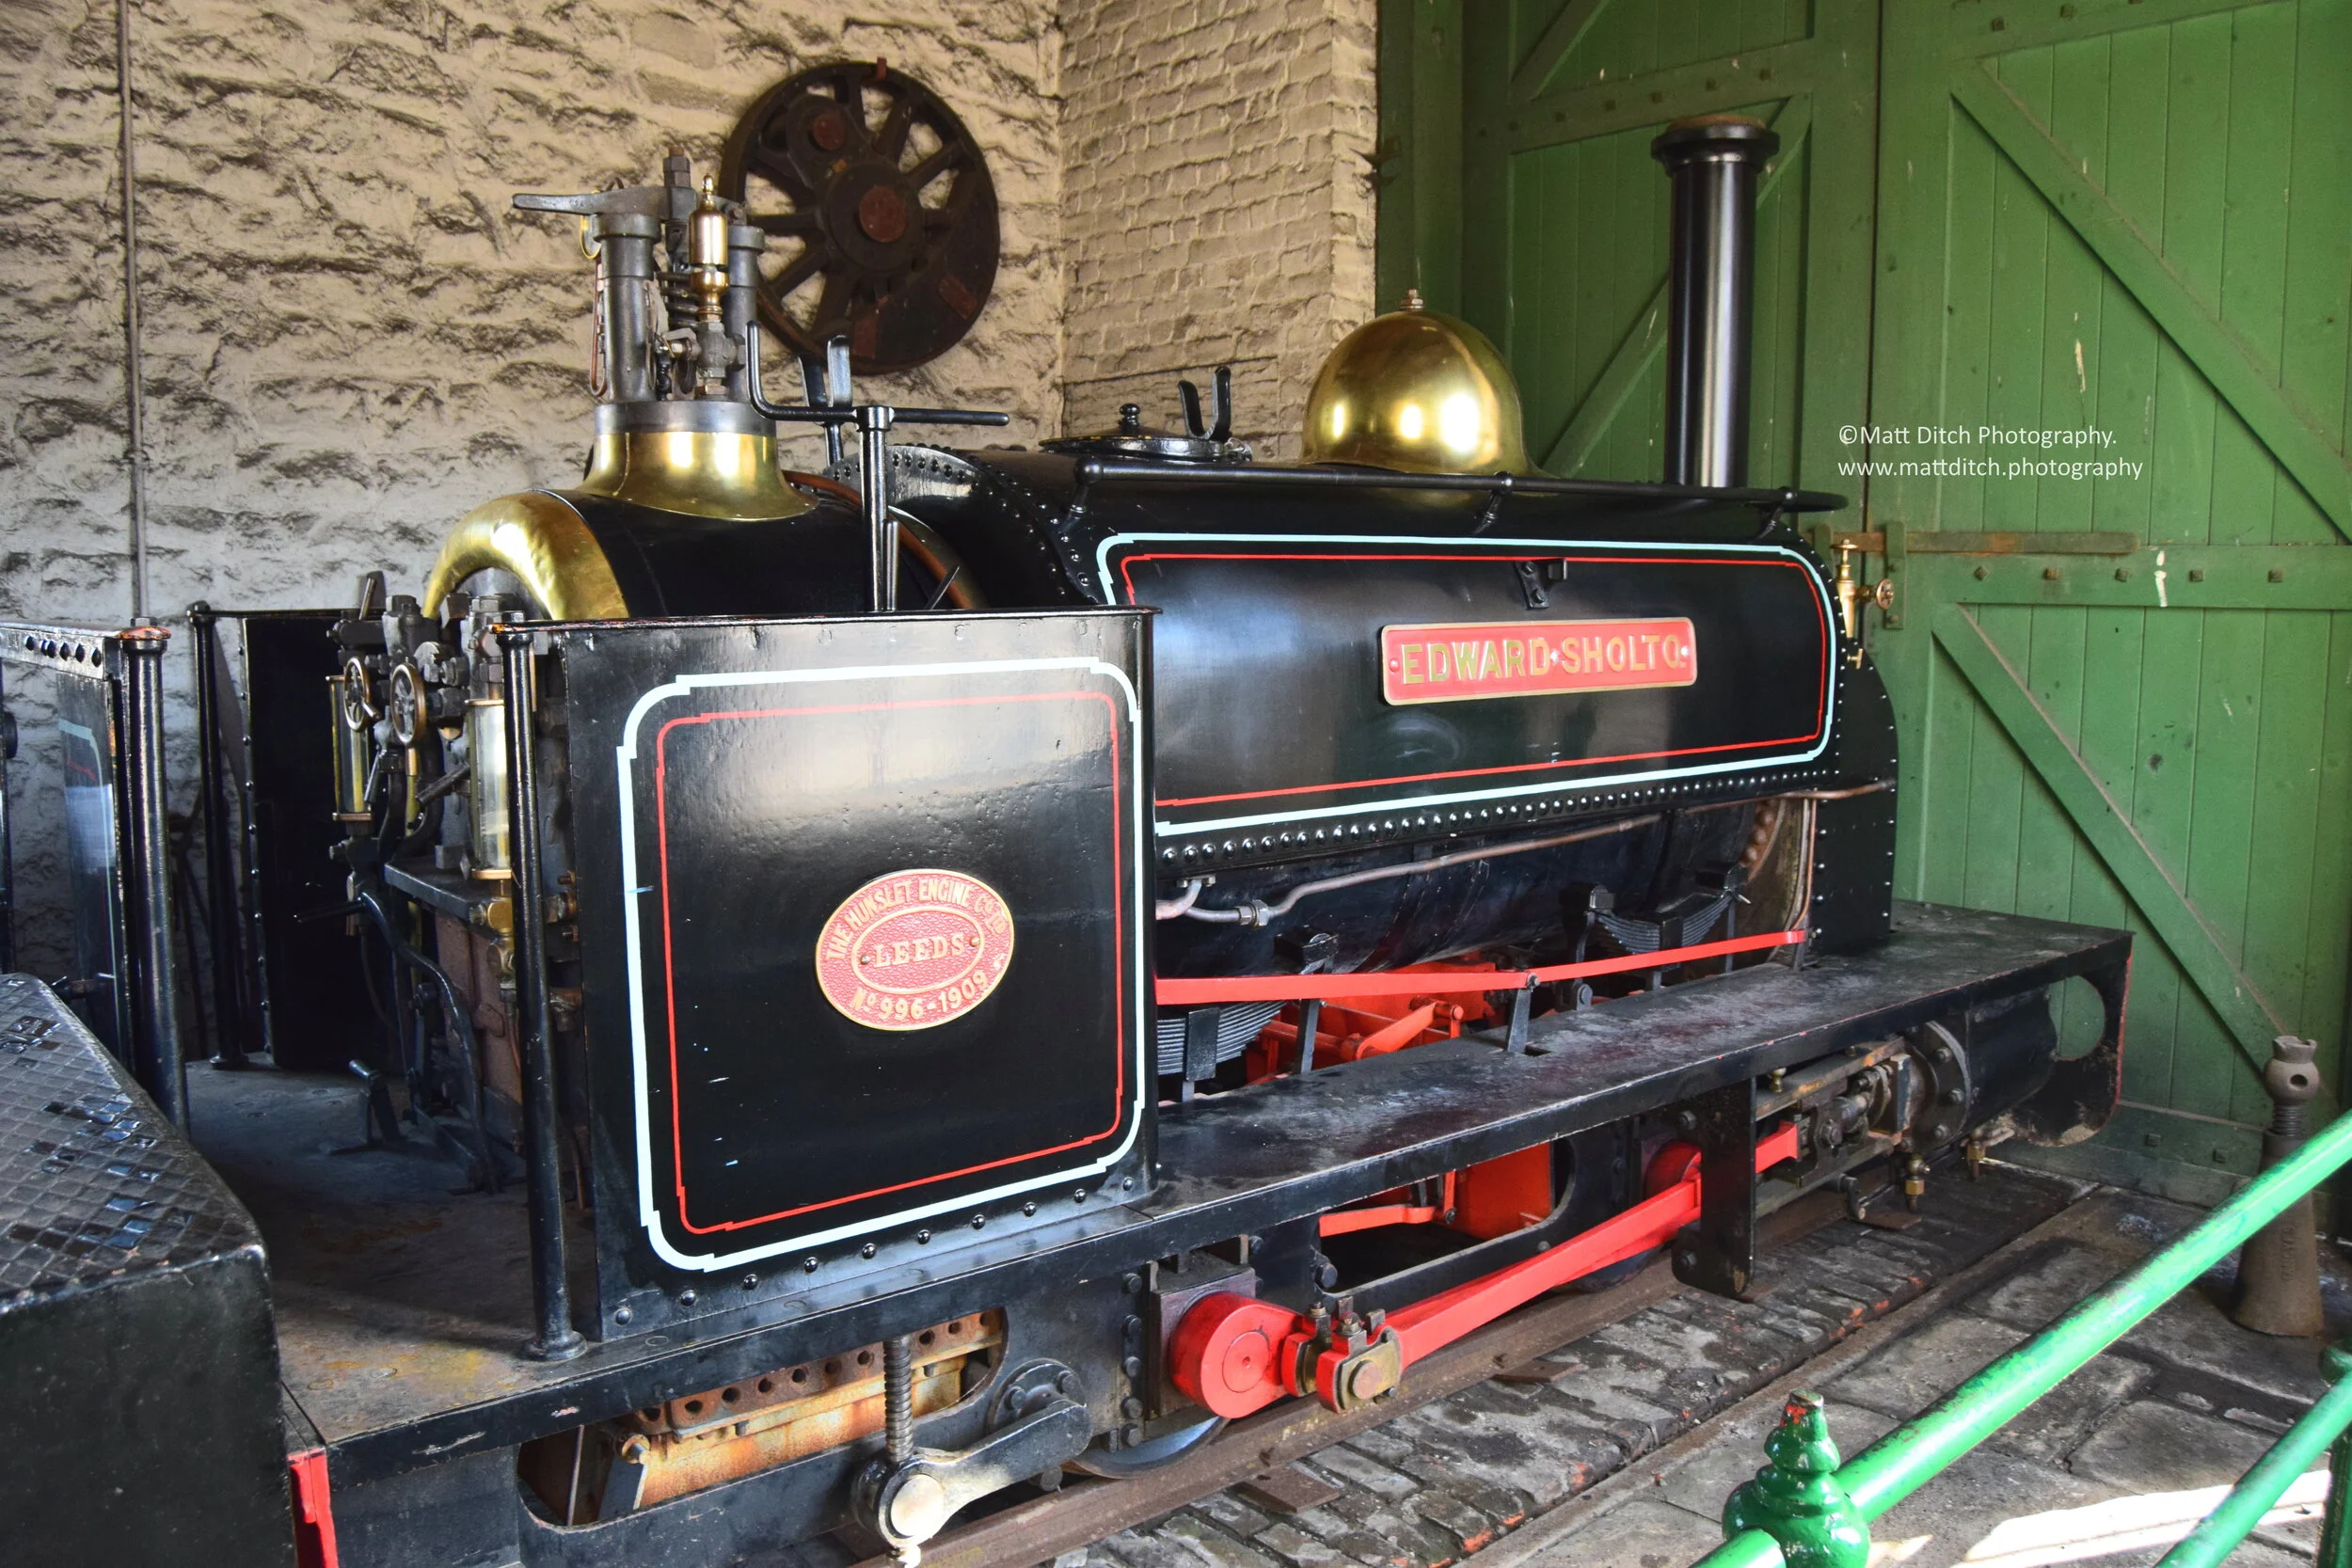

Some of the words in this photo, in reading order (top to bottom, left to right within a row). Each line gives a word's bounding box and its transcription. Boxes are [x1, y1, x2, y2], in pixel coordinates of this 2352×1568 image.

[1402, 637, 1549, 685] EDWARD
[825, 926, 853, 960] THE
[843, 880, 913, 931] HUNSLET
[918, 879, 970, 907] ENGINE
[873, 933, 965, 968] LEEDS
